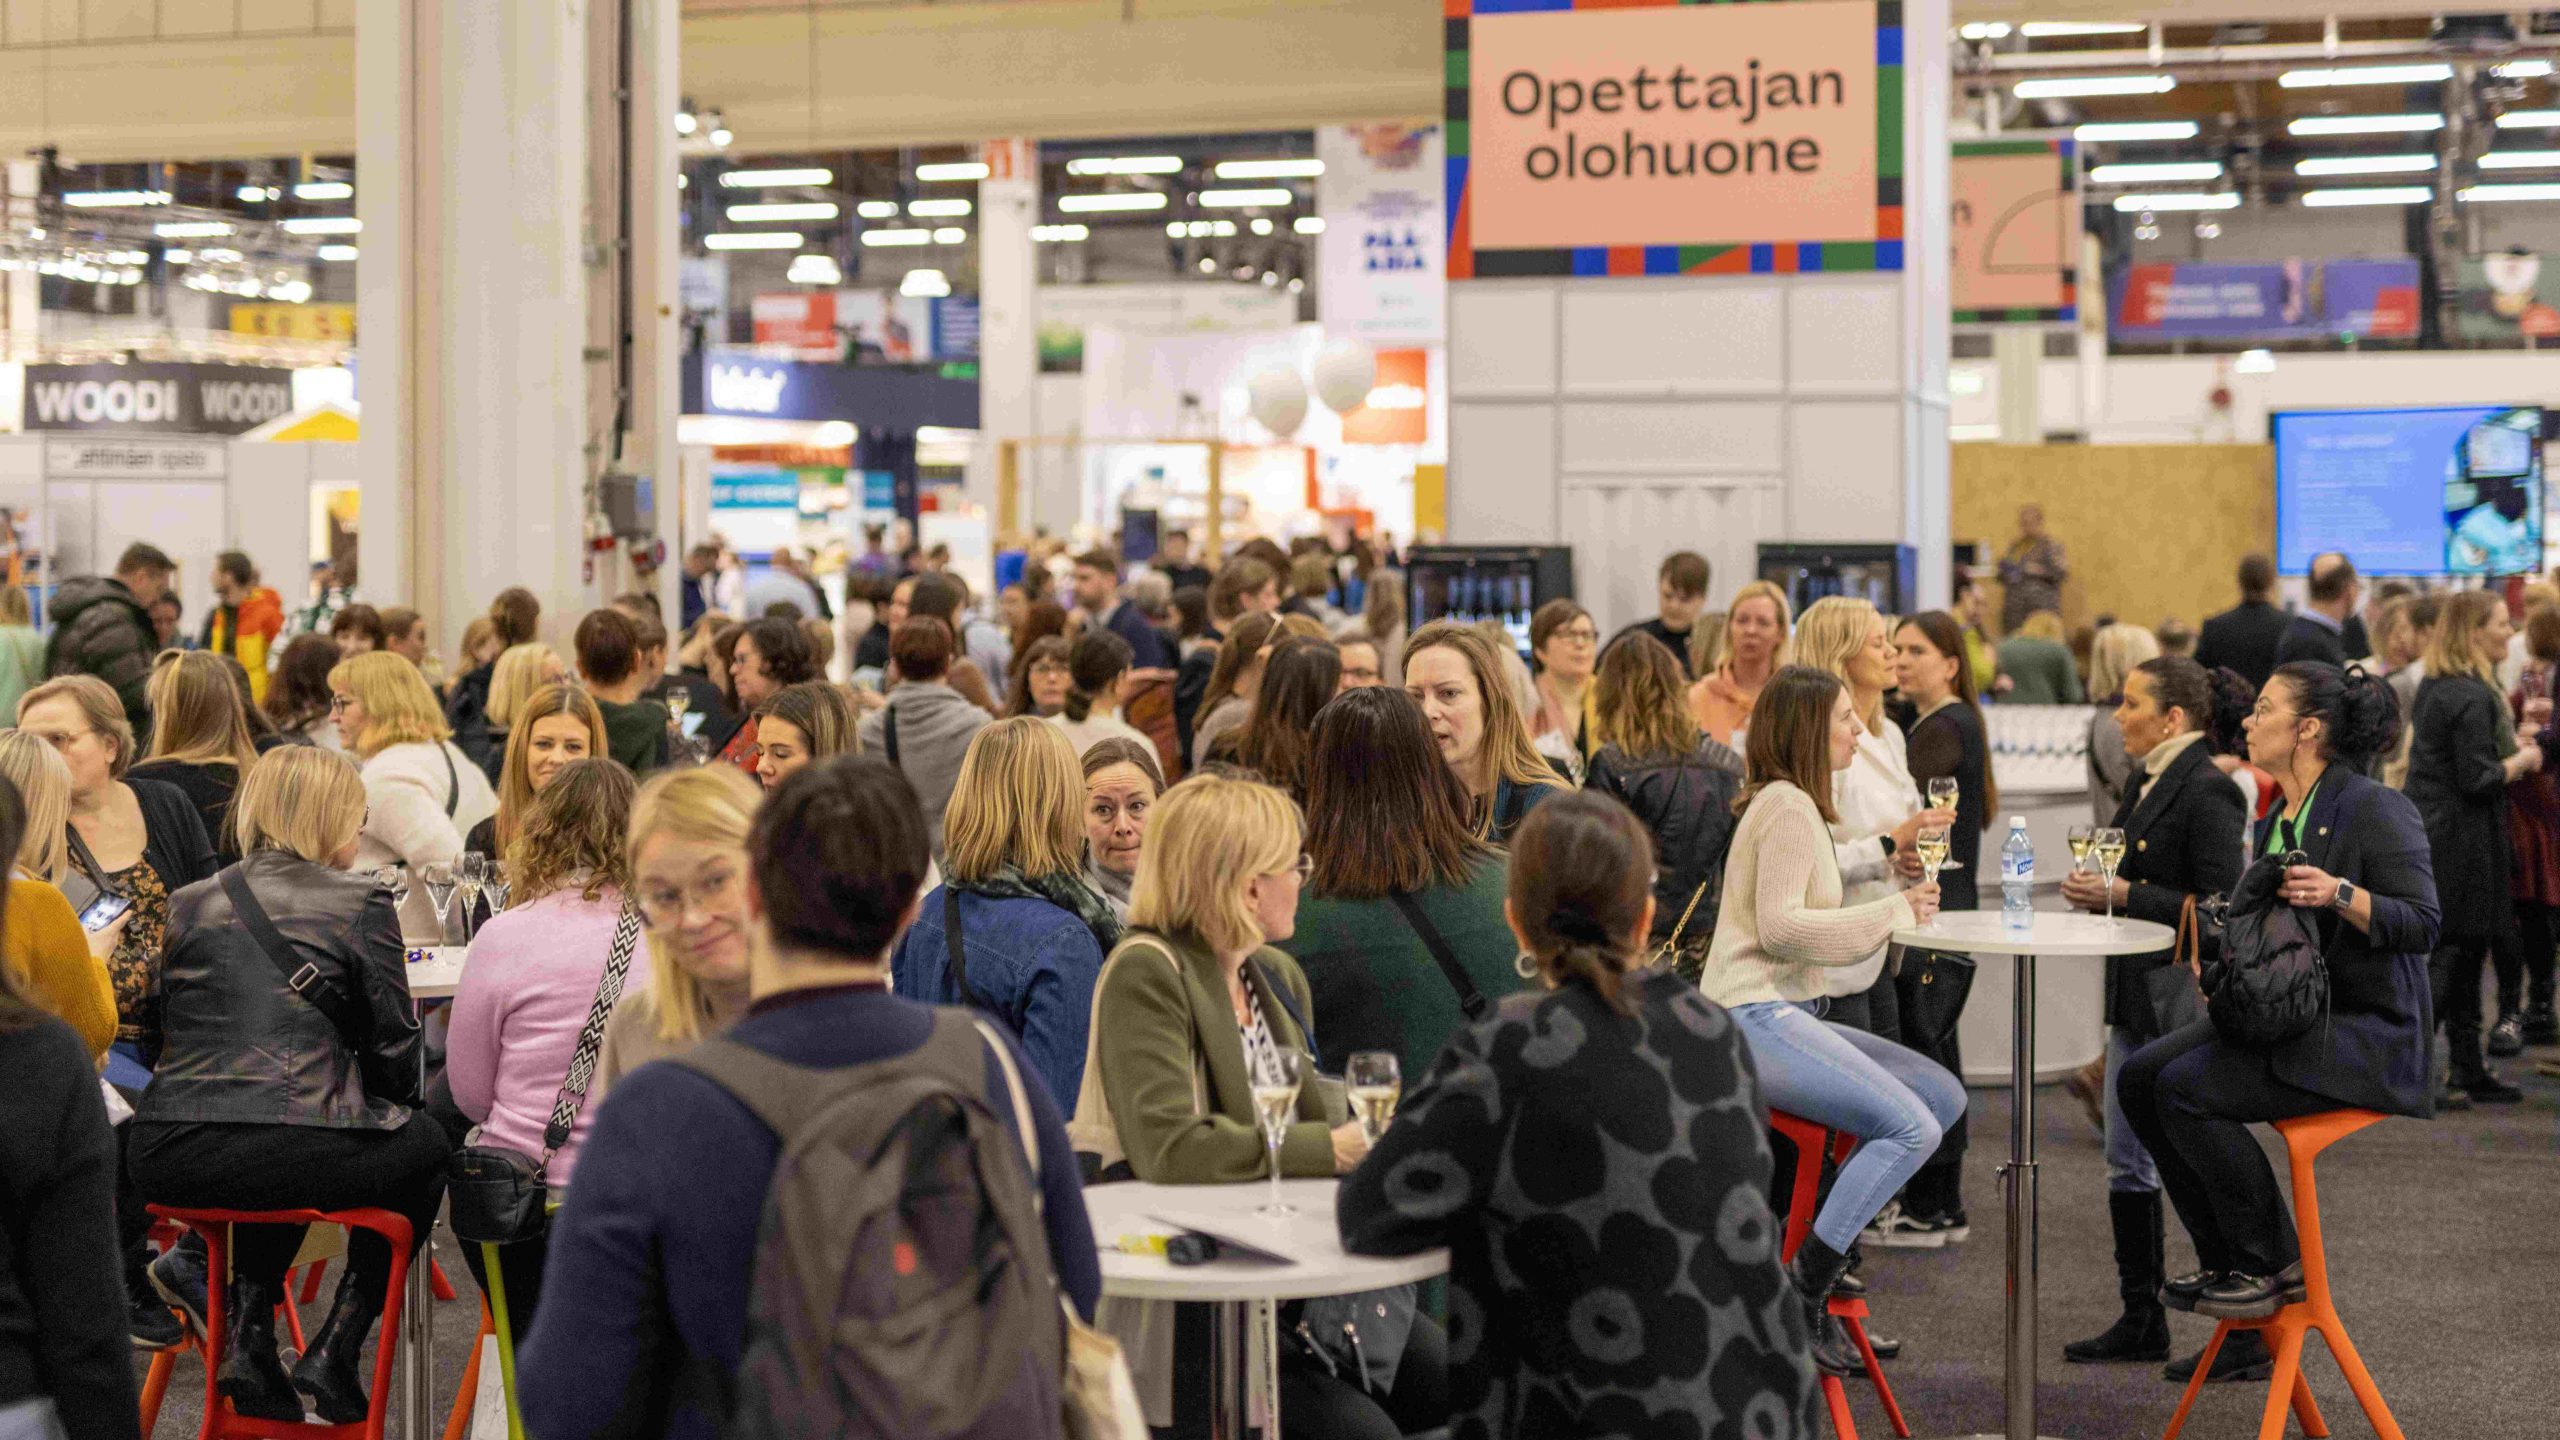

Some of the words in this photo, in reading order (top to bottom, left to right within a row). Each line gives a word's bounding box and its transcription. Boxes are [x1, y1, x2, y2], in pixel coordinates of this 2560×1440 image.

[1502, 59, 1845, 130] Opettajan
[1525, 129, 1821, 181] olohuone
[33, 380, 179, 423] WOODI
[200, 381, 289, 423] WOODI
